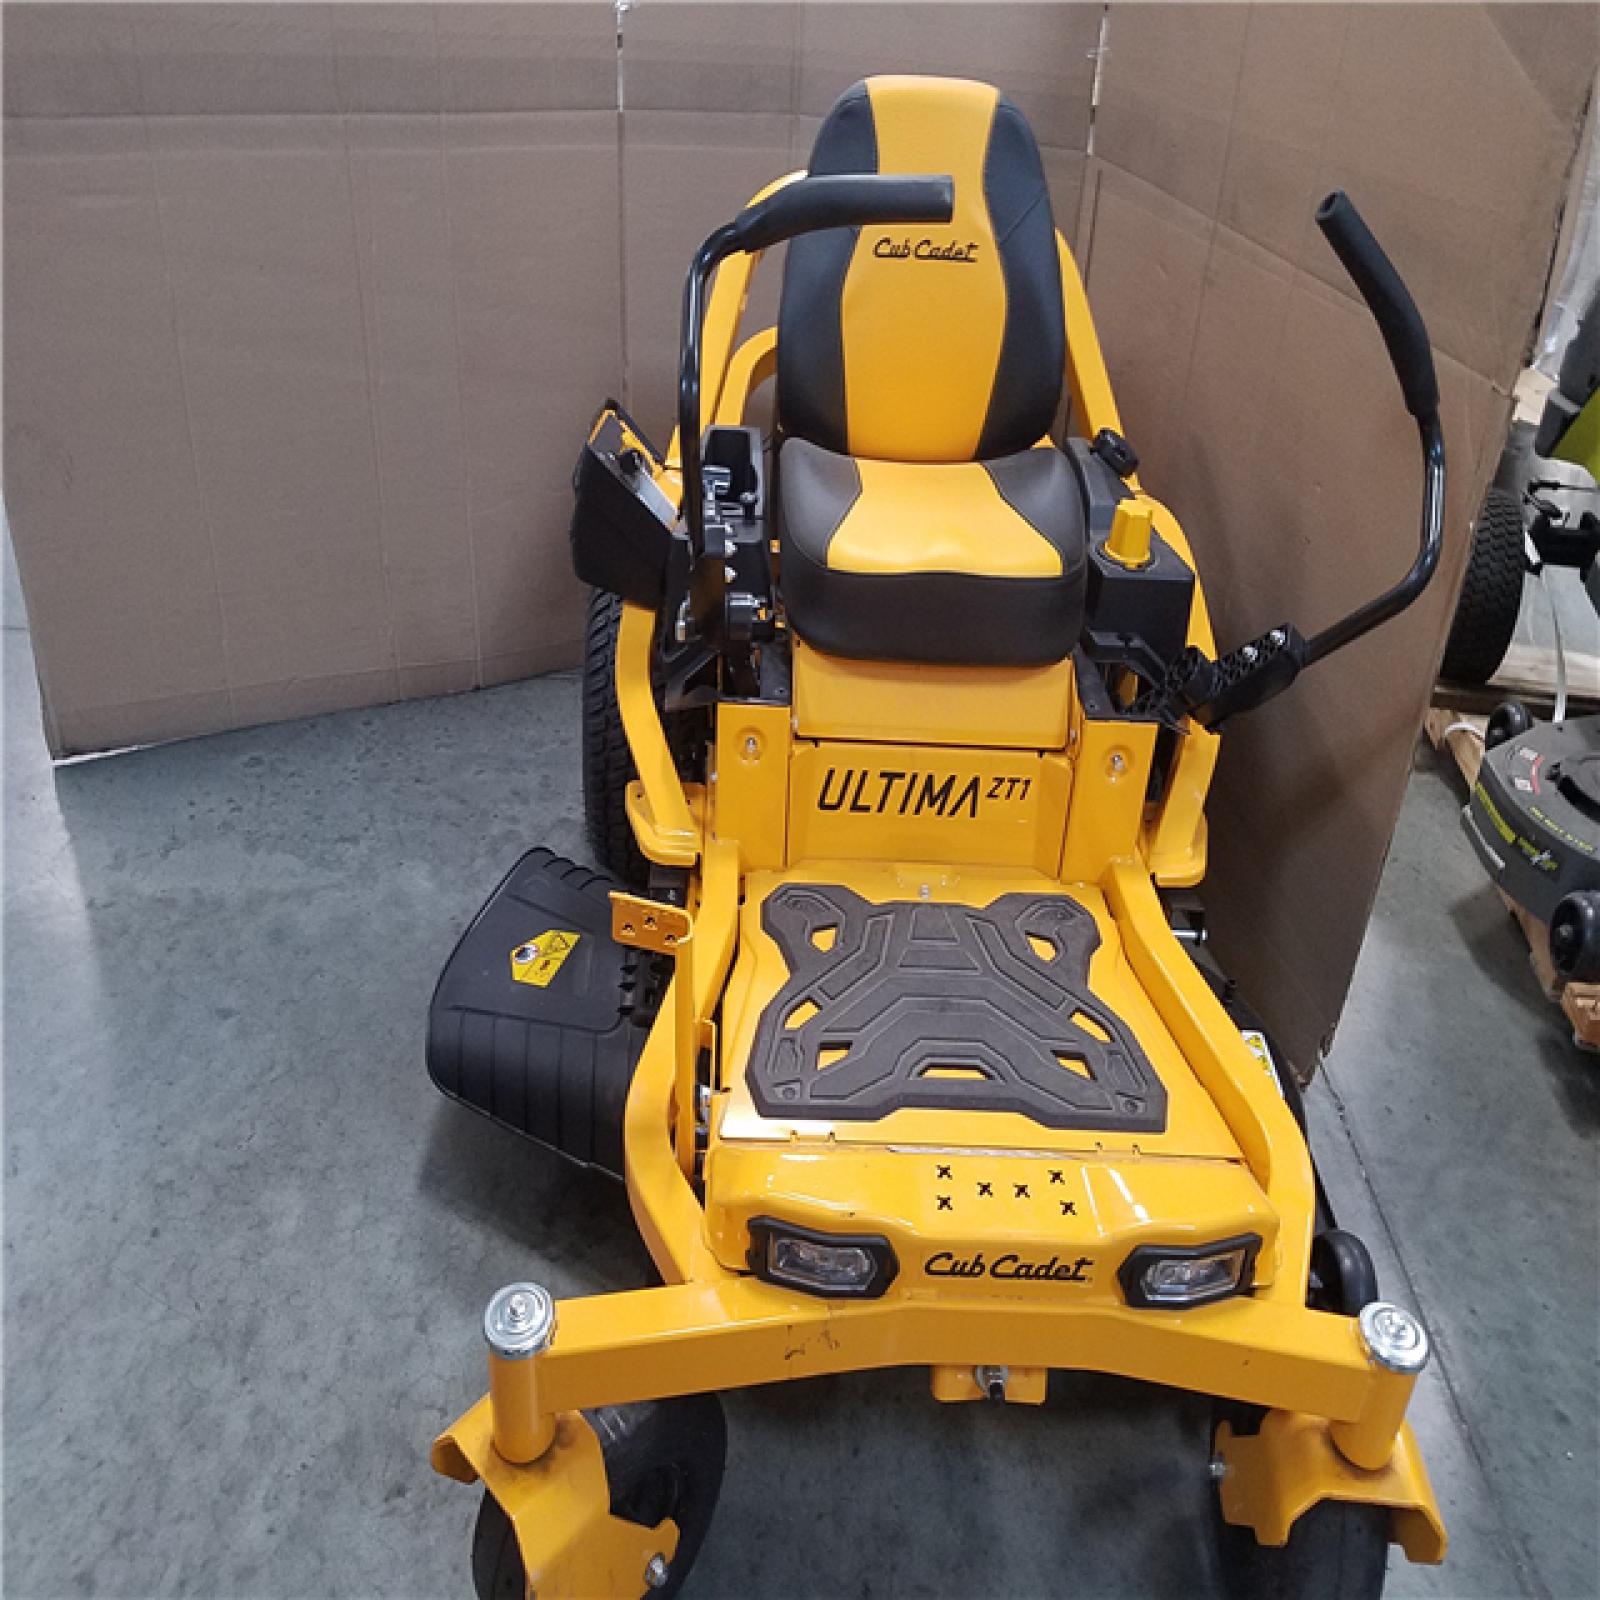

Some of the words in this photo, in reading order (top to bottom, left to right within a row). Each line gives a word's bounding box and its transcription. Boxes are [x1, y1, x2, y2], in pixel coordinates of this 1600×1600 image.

[874, 237, 911, 258] Cub
[914, 239, 980, 263] Cadet
[817, 767, 981, 818] ULTIMA
[985, 776, 1032, 801] ZT1
[924, 1251, 986, 1277] Cub
[989, 1254, 1095, 1281] Cadet
